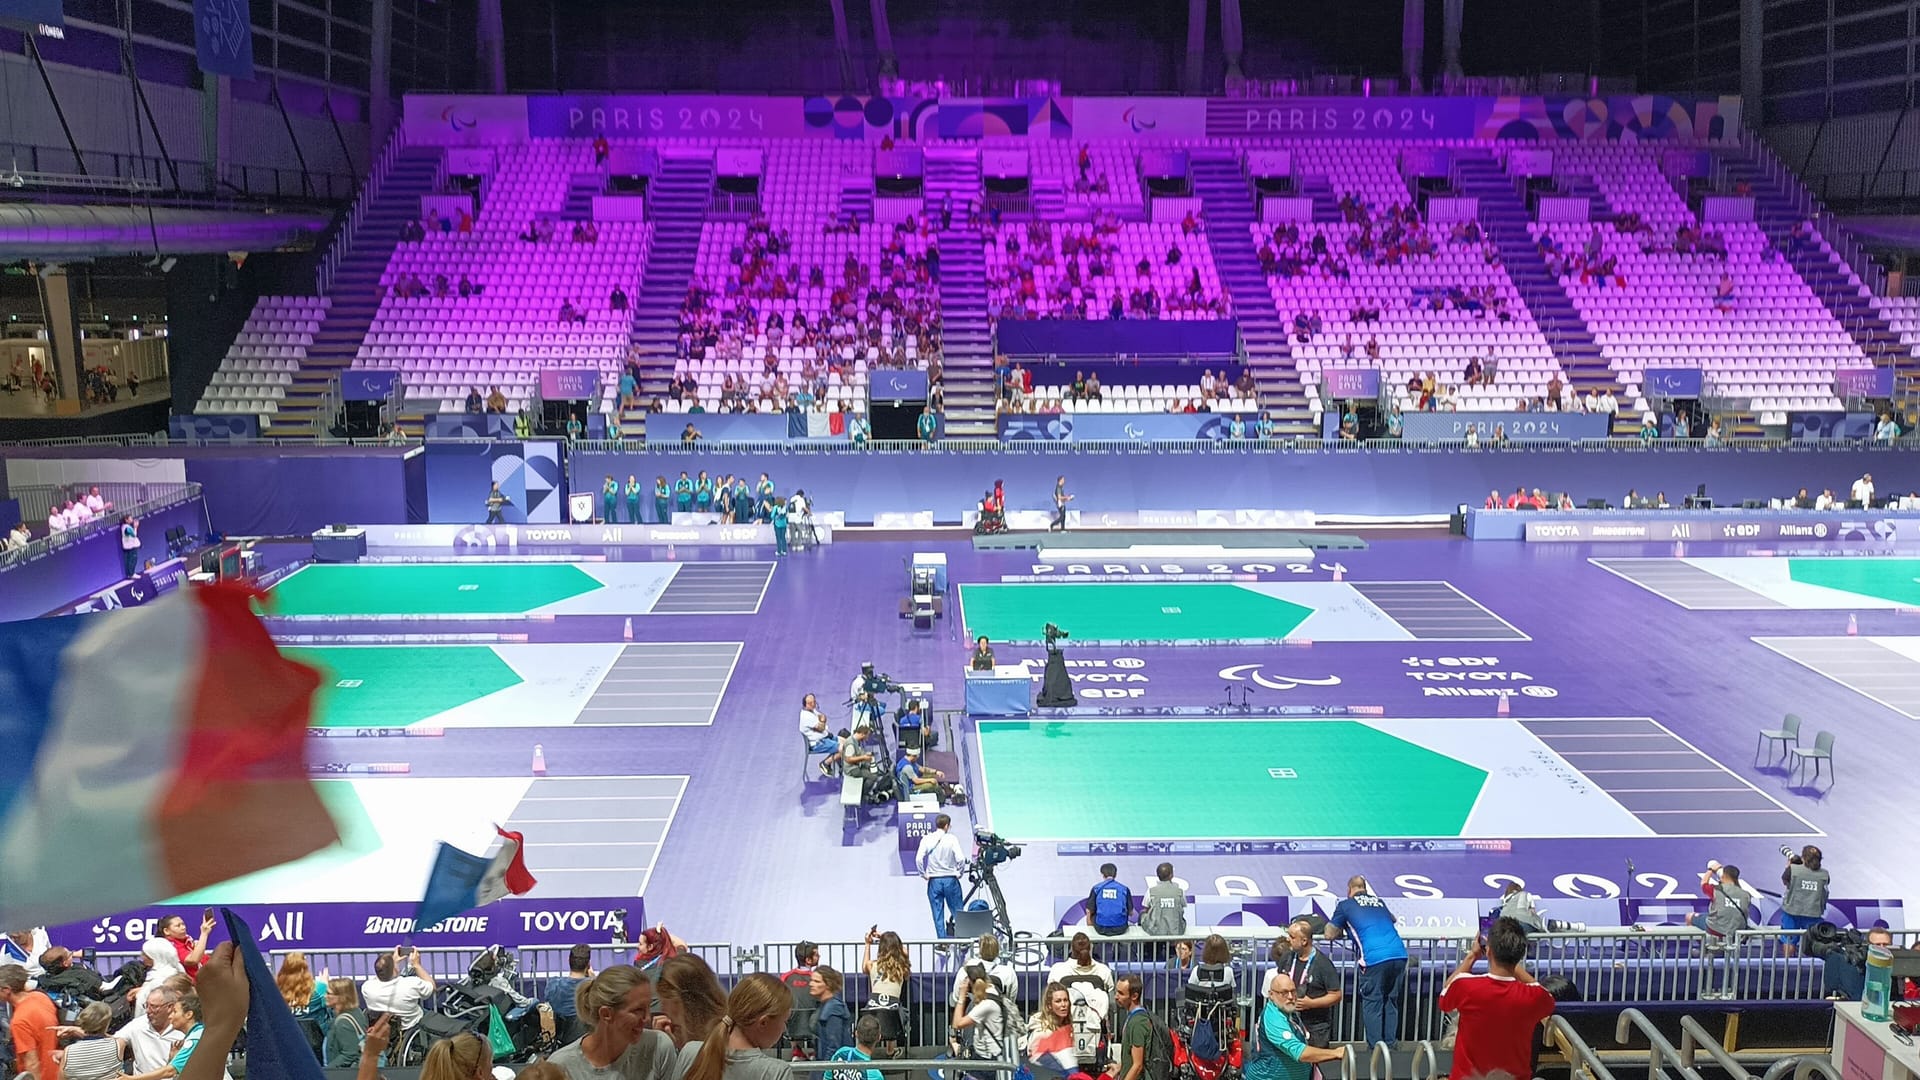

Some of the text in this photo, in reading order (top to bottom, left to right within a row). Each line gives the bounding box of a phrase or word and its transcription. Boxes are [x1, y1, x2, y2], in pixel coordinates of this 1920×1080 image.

[569, 107, 763, 130] PARIS 2024
[1246, 108, 1435, 131] PARIS 2024
[1338, 374, 1362, 382] PARIS
[1512, 420, 1559, 435] 2024
[526, 530, 572, 541] TOYOTA
[1535, 525, 1580, 537] TOYOTA
[1779, 524, 1813, 536] Allianz
[1032, 562, 1347, 575] PARIS 2024
[1021, 658, 1108, 668] Alanz
[1029, 673, 1149, 682] TYOTA
[1405, 672, 1534, 681] TOYOTA
[1422, 687, 1519, 697] Allianz
[906, 822, 932, 830] PARIS
[364, 916, 489, 934] BRIDSTONE
[519, 911, 618, 932] TOYOTA
